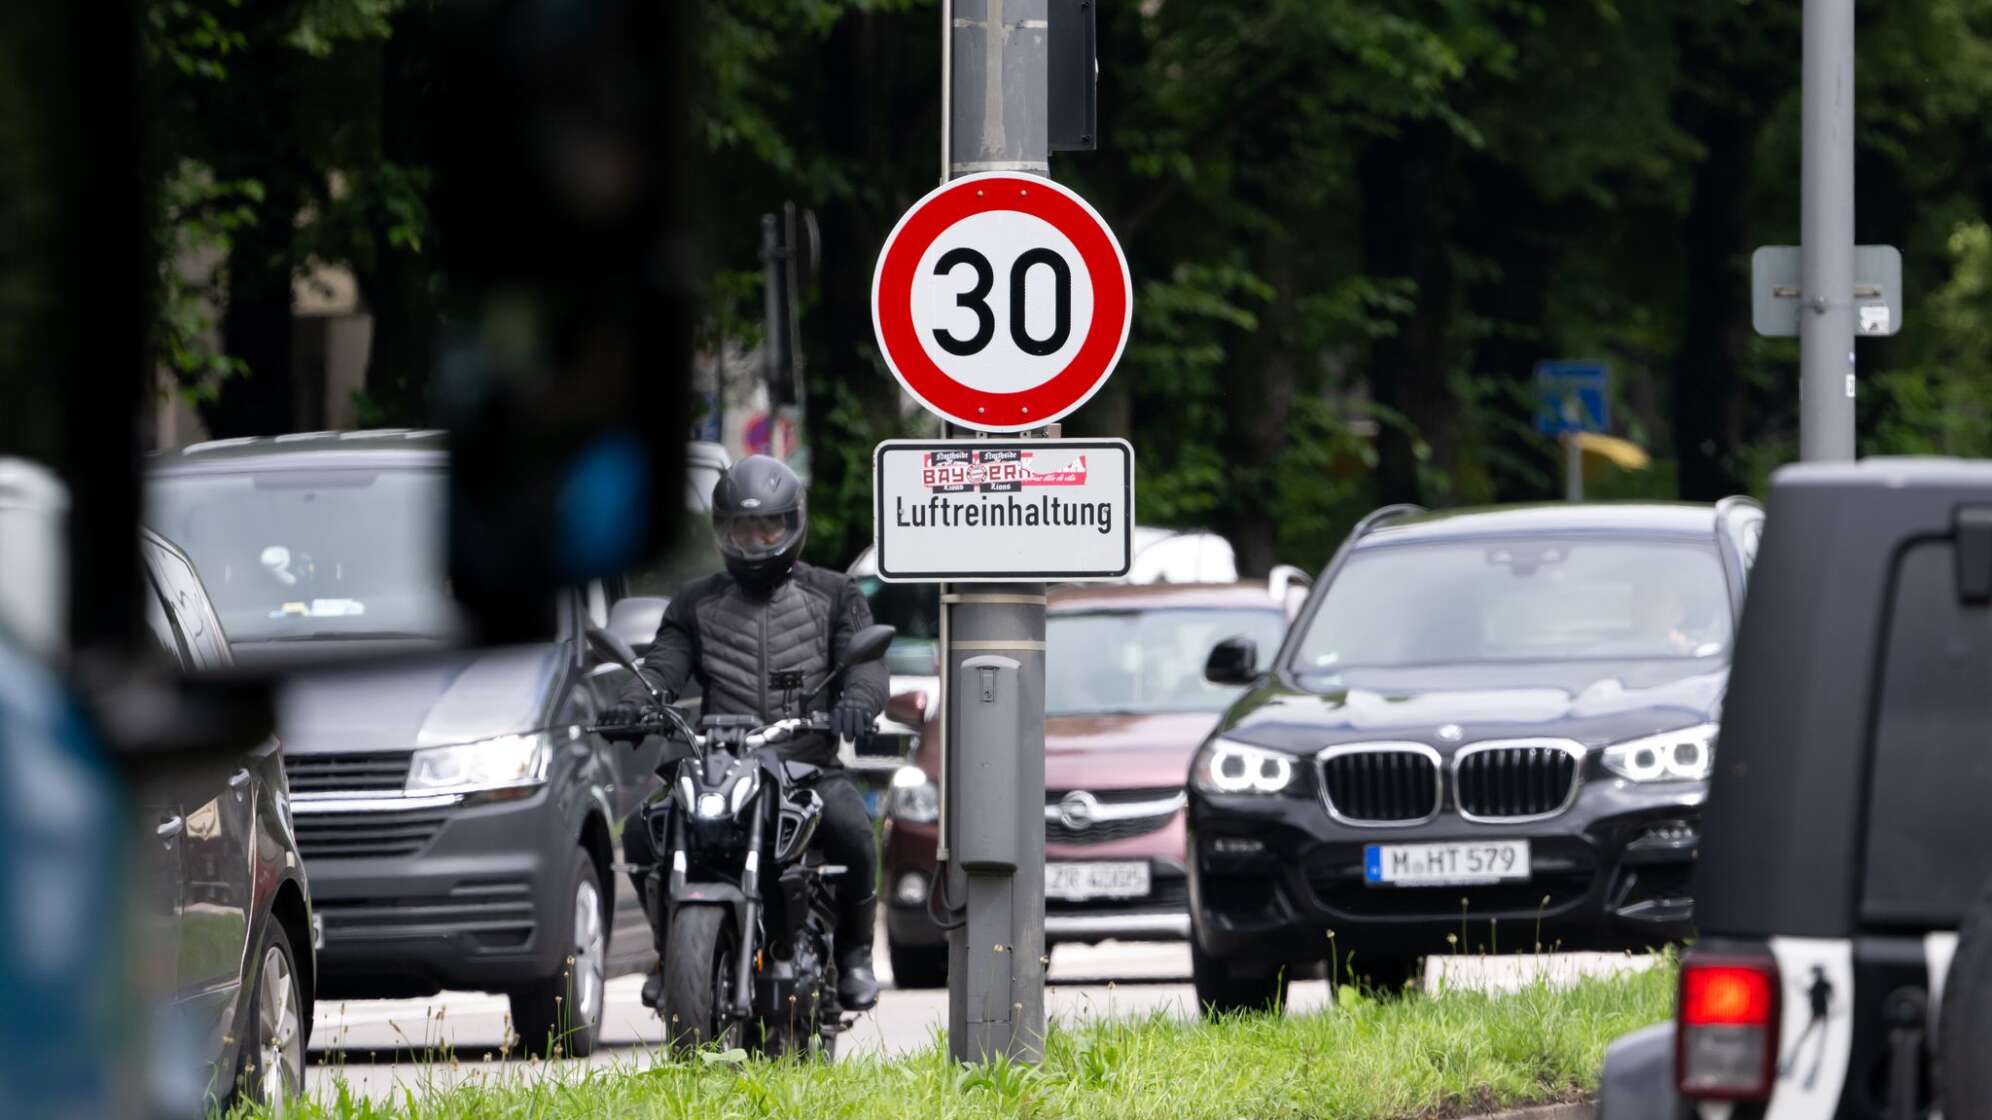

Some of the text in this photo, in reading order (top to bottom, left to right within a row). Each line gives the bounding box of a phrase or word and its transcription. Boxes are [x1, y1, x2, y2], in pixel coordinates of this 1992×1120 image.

[931, 247, 1072, 357] 30
[896, 495, 1112, 534] Luftreinhaltung
[1393, 846, 1516, 875] M HT 579
